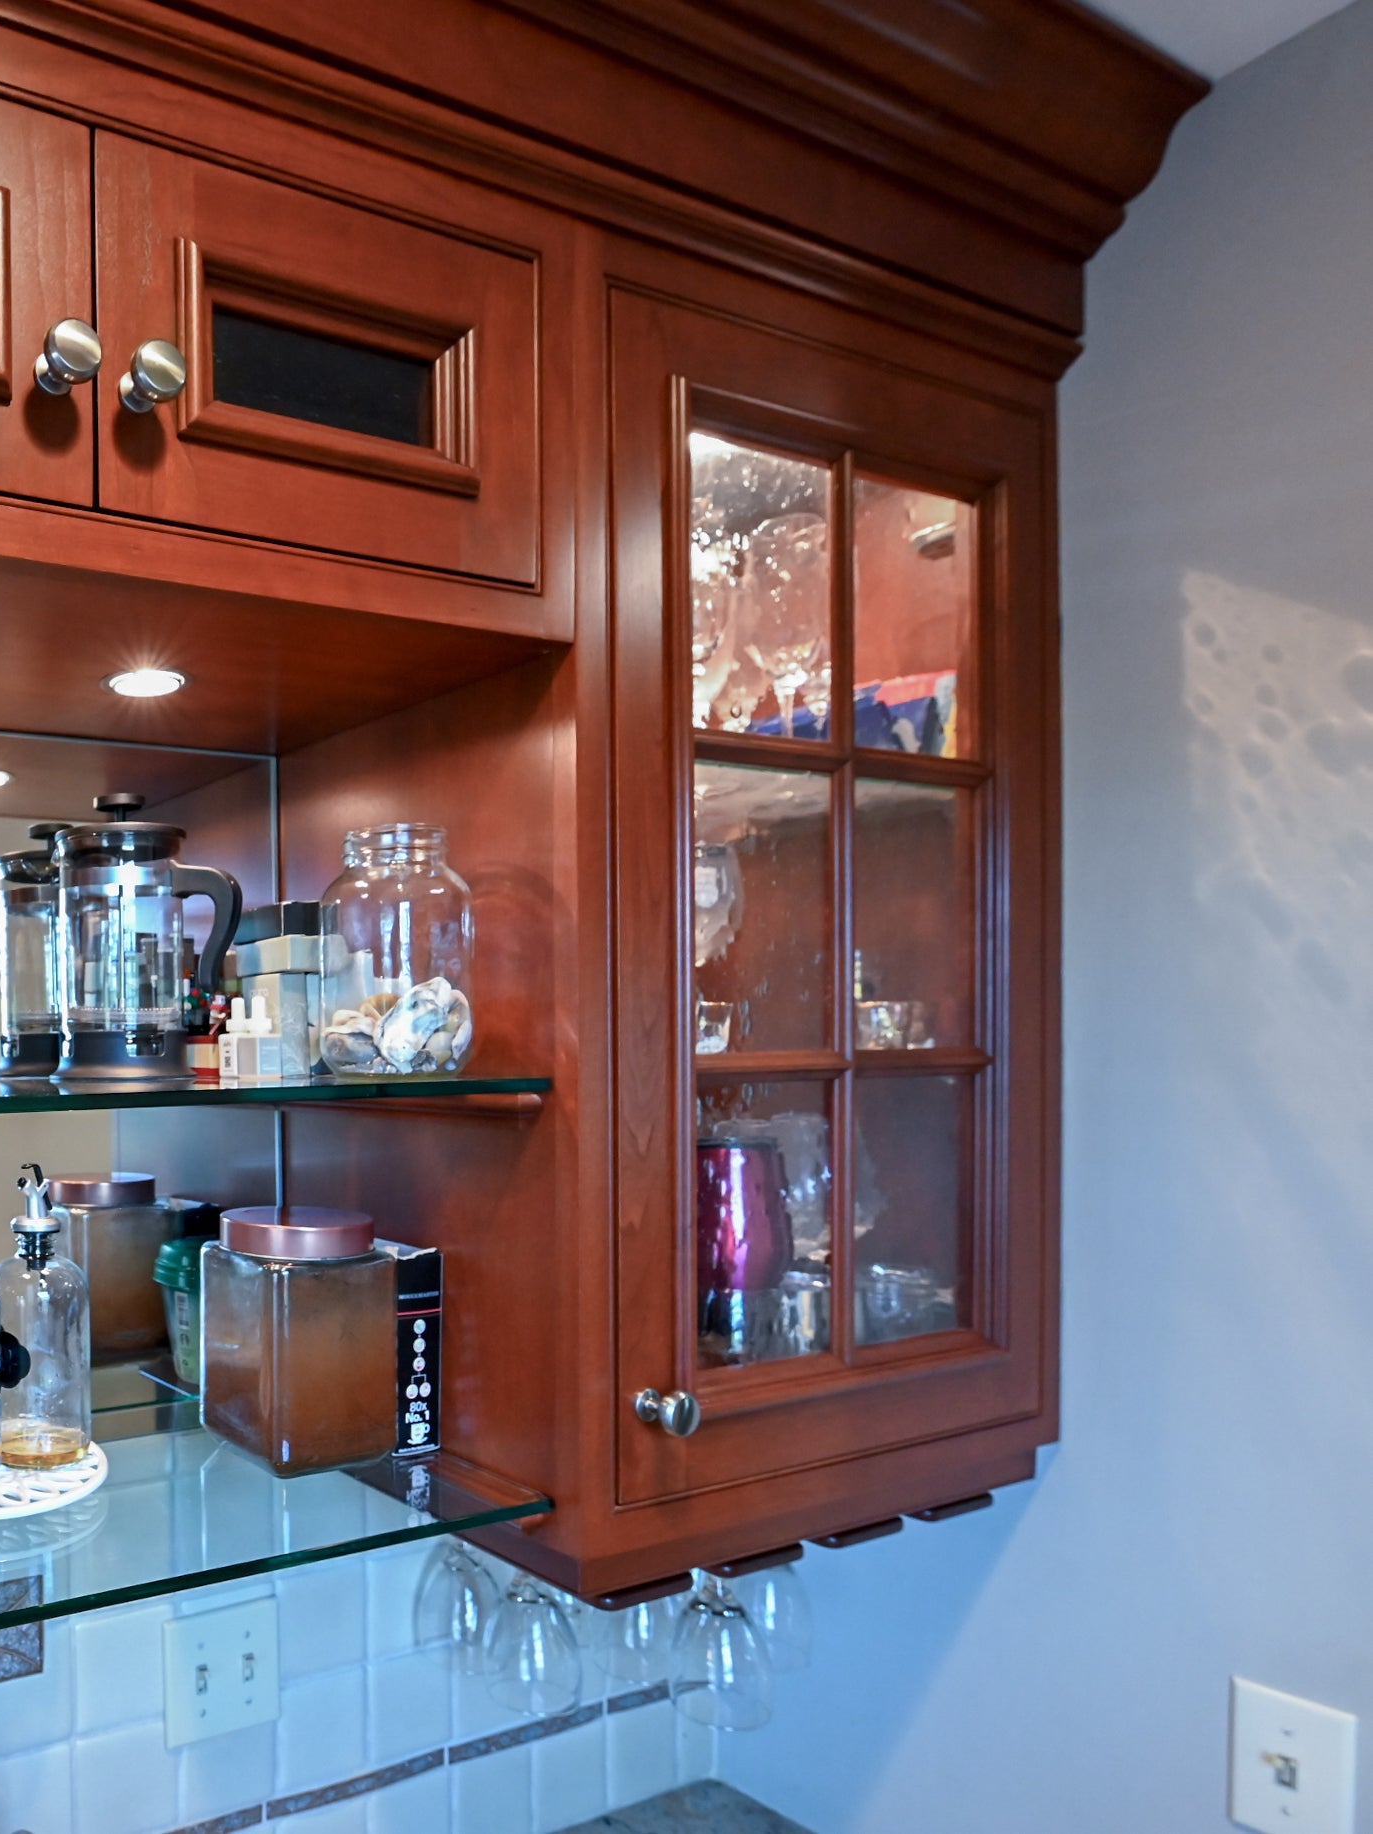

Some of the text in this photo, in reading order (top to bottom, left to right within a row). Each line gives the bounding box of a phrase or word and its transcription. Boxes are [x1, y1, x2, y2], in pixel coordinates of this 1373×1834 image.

[410, 1401, 428, 1412] 80x
[405, 1410, 430, 1424] No. 1
